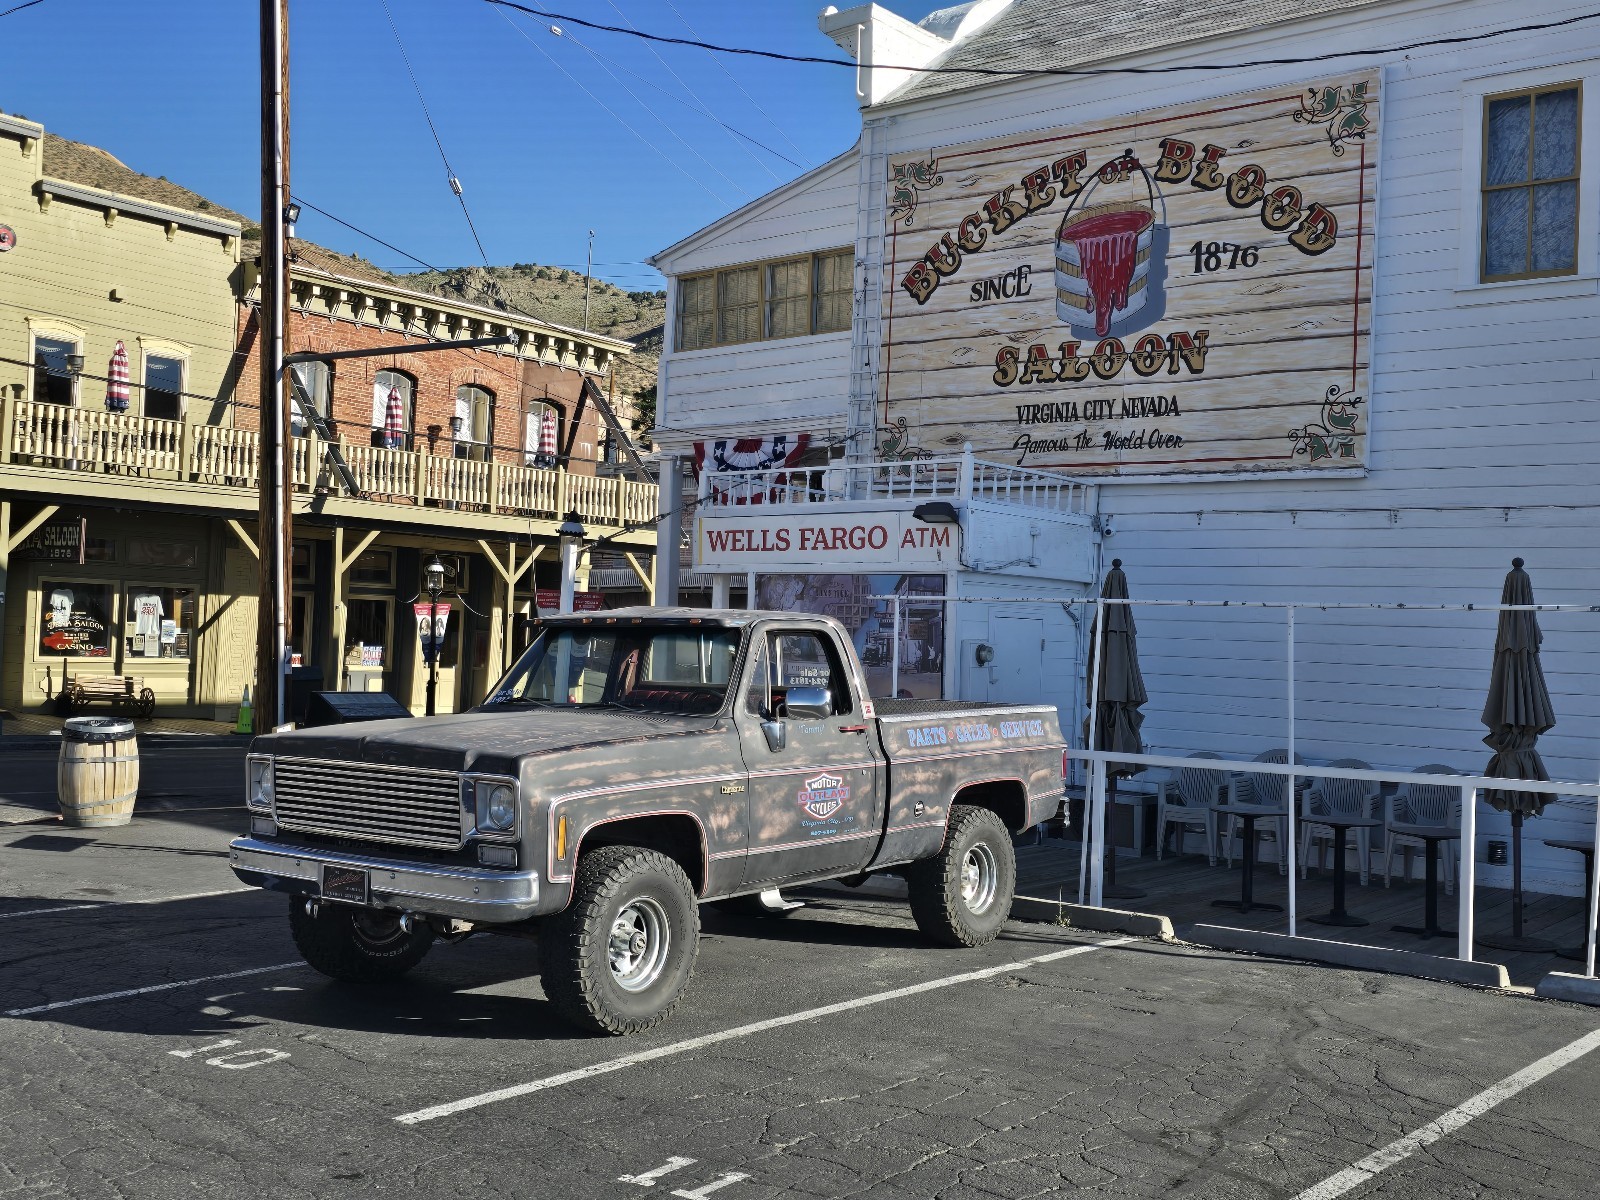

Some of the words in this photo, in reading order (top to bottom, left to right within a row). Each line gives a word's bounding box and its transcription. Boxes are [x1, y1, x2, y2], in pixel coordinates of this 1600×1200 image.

[901, 150, 1087, 305] BUCKET
[1154, 137, 1338, 256] BLOOD
[970, 265, 1032, 302] SINCE
[1189, 240, 1259, 273] 1876
[993, 330, 1209, 387] SALOON
[1016, 402, 1080, 425] VIRGINIA
[1083, 398, 1116, 420] CITY
[1121, 395, 1181, 419] NEVADA
[1013, 433, 1069, 465] Famous
[1073, 429, 1096, 452] The
[1103, 428, 1144, 451] World
[1148, 428, 1185, 450] Over
[44, 526, 79, 546] SALOON
[707, 528, 790, 552] WELLS
[798, 525, 888, 550] FARGO
[901, 527, 950, 548] ATM
[907, 726, 946, 747] PARTS
[955, 724, 991, 742] SALES
[1000, 720, 1044, 738] SERVICE
[800, 788, 847, 802] OUTLAW
[812, 779, 837, 790] MOTOR
[810, 801, 837, 814] CYCLES
